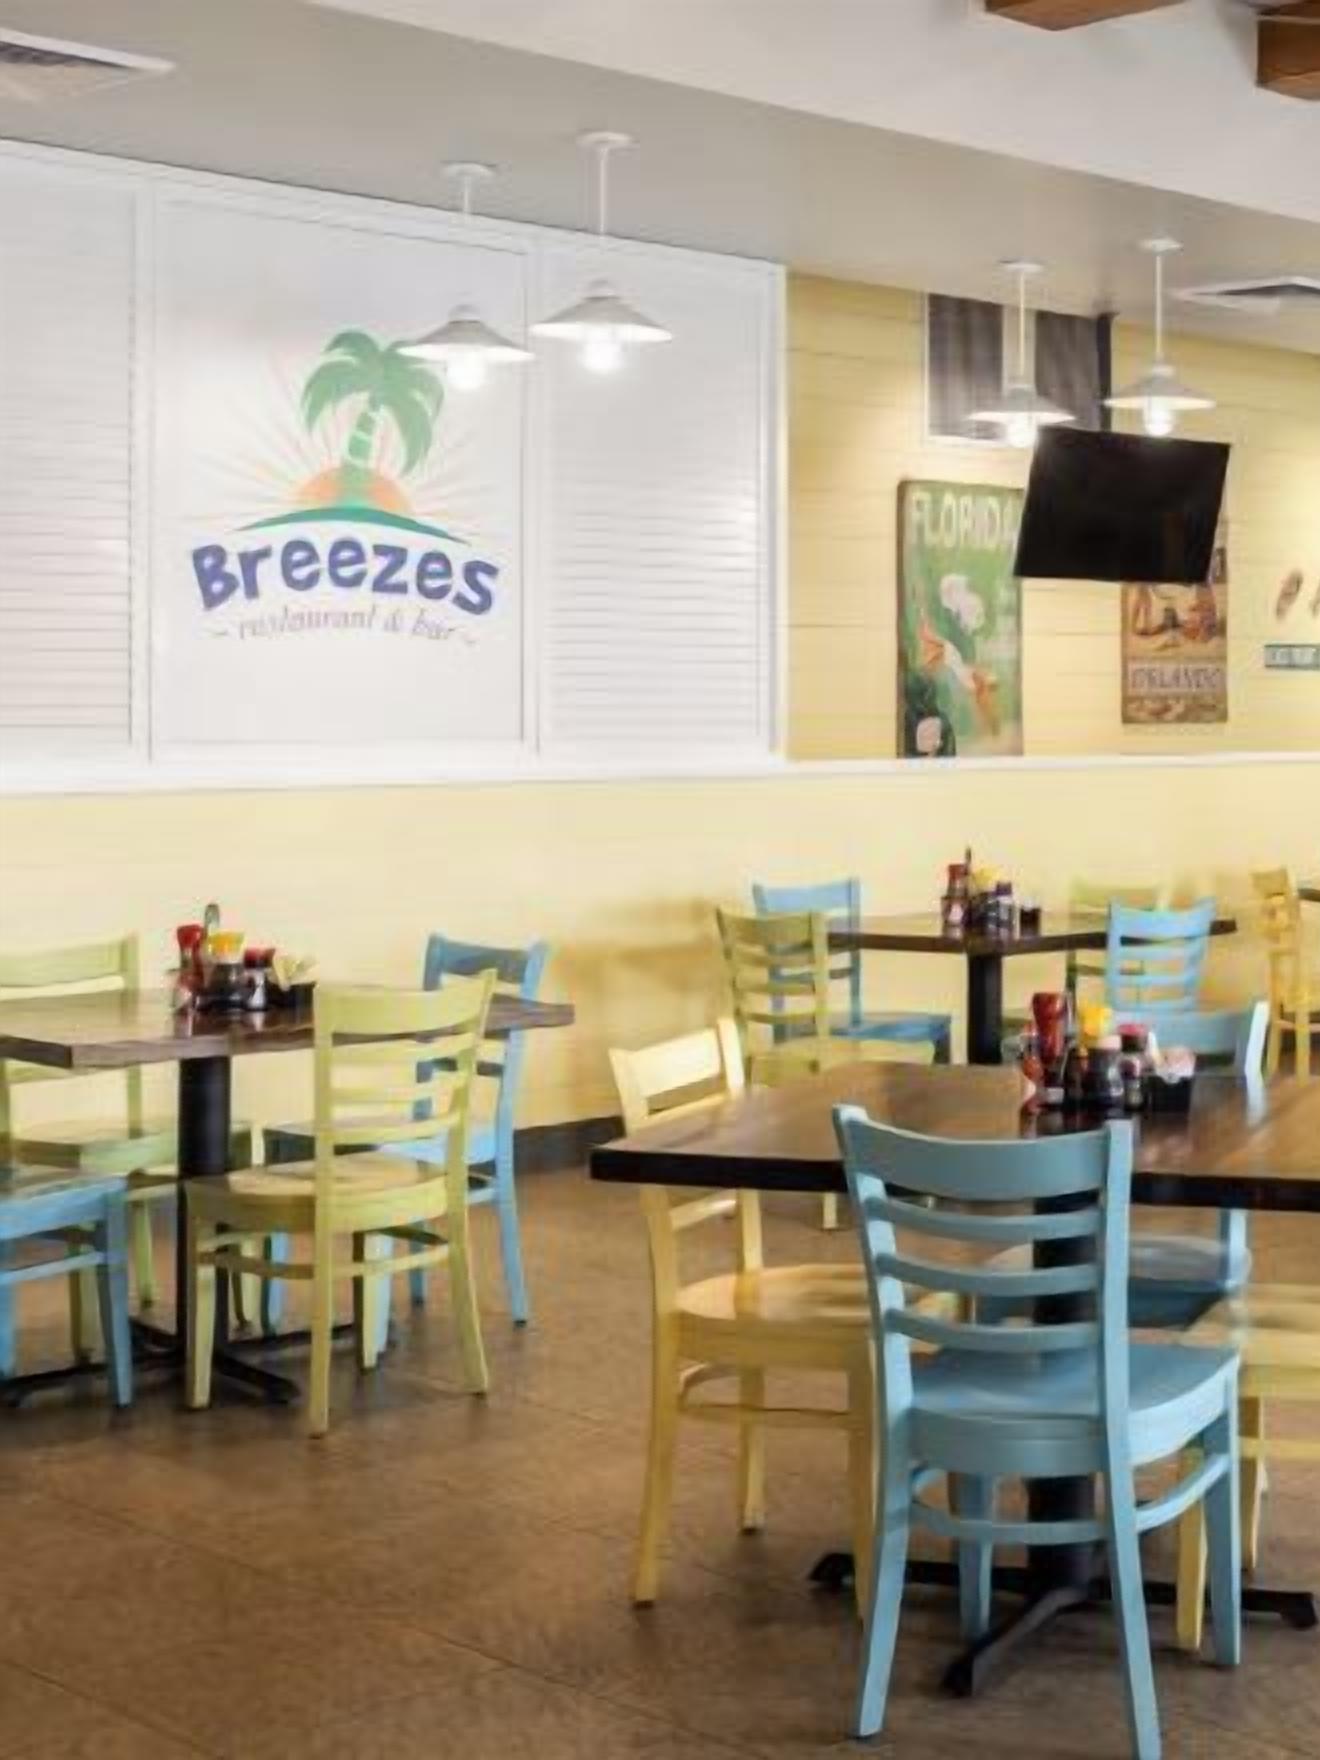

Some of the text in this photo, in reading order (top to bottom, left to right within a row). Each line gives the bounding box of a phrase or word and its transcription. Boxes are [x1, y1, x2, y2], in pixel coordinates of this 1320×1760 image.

[191, 536, 500, 615] Breezes
[238, 603, 378, 640] restaurant
[411, 606, 455, 640] bar
